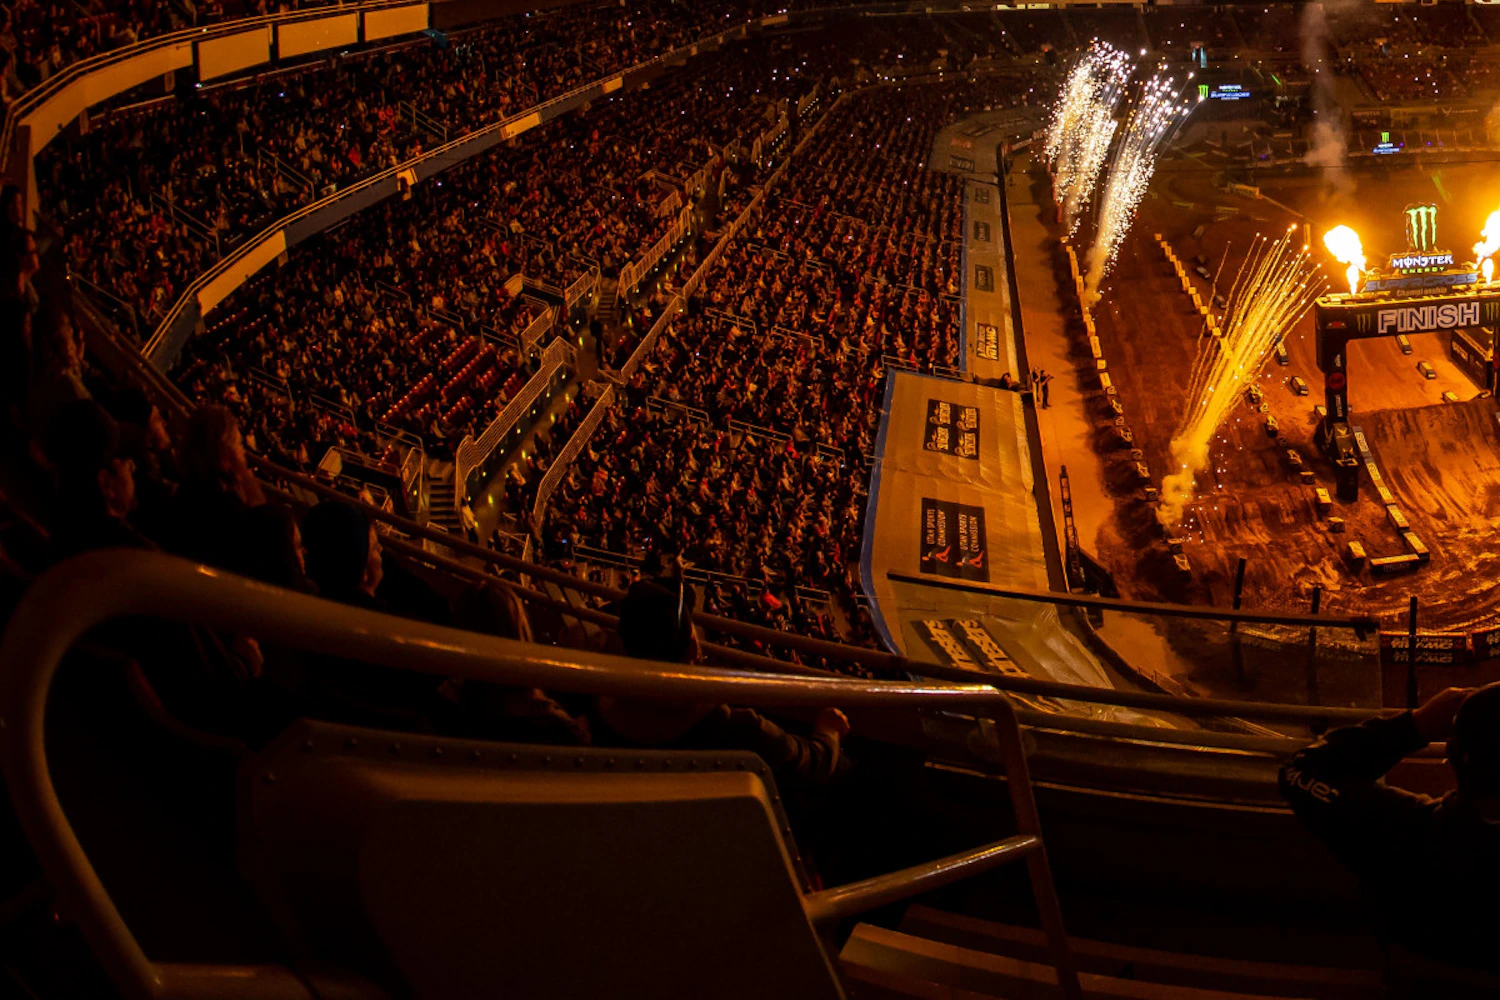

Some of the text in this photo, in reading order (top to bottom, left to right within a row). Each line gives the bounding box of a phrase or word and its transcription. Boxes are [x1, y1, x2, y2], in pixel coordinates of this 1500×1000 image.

[1392, 254, 1454, 269] MONSTER
[1401, 266, 1445, 274] ENERGY
[1365, 274, 1479, 291] SUPERCROSS
[1396, 287, 1447, 297] Championship
[1377, 301, 1480, 334] FINISH
[926, 508, 936, 529] SPORTS
[959, 513, 968, 534] SPORTS
